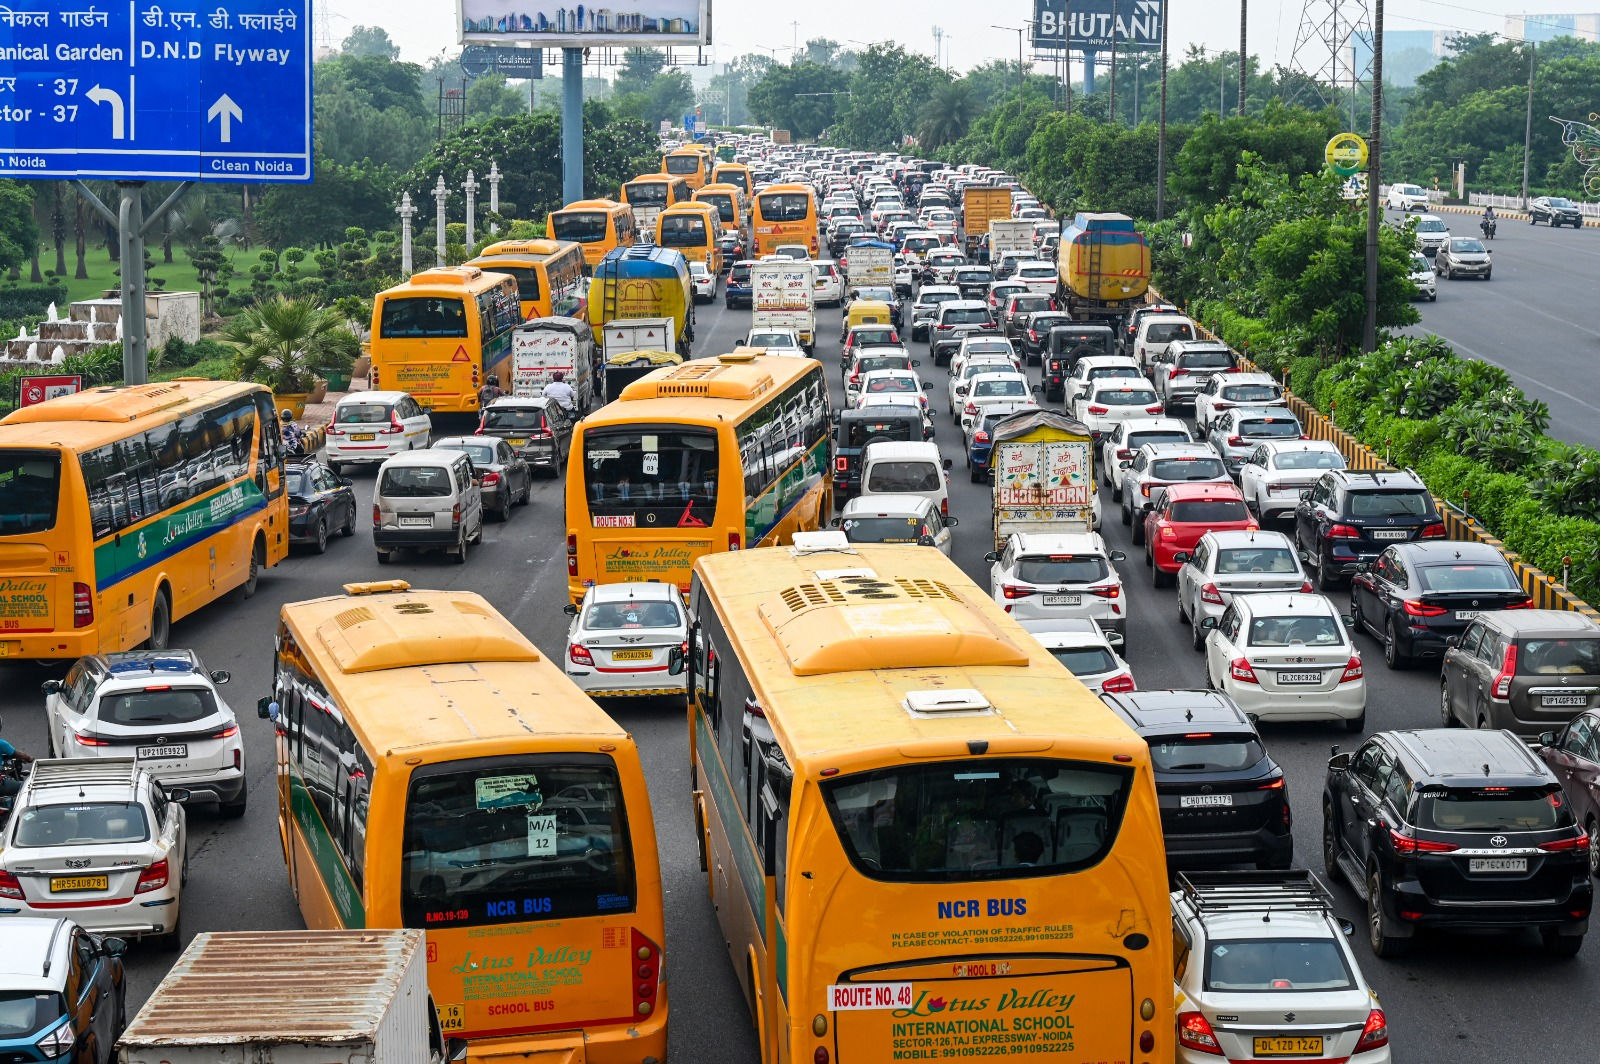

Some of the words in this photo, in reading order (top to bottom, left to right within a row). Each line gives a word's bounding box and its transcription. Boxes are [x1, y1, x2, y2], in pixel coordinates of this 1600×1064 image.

[60, 6, 108, 27] गार्डन
[238, 9, 297, 33] फ्लाईवे
[1041, 11, 1157, 39] BHUTANI
[55, 44, 123, 61] Garden
[141, 41, 201, 59] D.N.D
[215, 44, 290, 65] Flyway
[54, 79, 78, 95] 37
[53, 104, 78, 122] 37
[9, 156, 46, 168] Noida
[211, 160, 250, 172] Clean
[254, 160, 293, 172] Noida
[1000, 488, 1041, 504] BLOW
[1046, 486, 1088, 504] HORN
[597, 517, 615, 527] ROUTE
[618, 516, 633, 527] NO.3
[654, 547, 691, 558] Valley
[11, 594, 47, 602] SCHOOL
[5, 620, 19, 628] BUS
[529, 819, 555, 832] M/A
[536, 838, 549, 848] 12
[56, 879, 106, 889] HR55AU8781
[487, 901, 516, 917] NCR
[524, 897, 552, 914] BUS
[938, 900, 980, 919] NCR
[987, 898, 1026, 916] BUS
[943, 929, 988, 938] VIOLATION
[1005, 926, 1041, 935] TRAFFIC
[892, 940, 928, 948] PLEASE
[528, 946, 592, 968] Valley
[463, 970, 538, 985] INTERNATIONAL
[542, 967, 582, 979] SCHOOL
[957, 964, 988, 977] SCHOOL
[991, 963, 1007, 976] BUS
[834, 987, 872, 1007] ROUTE
[875, 988, 895, 1006] NO.
[898, 986, 911, 1006] 48
[998, 988, 1076, 1013] Valley
[448, 1007, 458, 1017] 16
[488, 1001, 530, 1016] SCHOOL
[534, 1000, 554, 1012] BUS
[892, 1019, 1009, 1037] INTERNATIONAL
[1013, 1015, 1075, 1032] SCHOOL
[1262, 1041, 1273, 1050] DL
[1297, 1040, 1320, 1050] 1247
